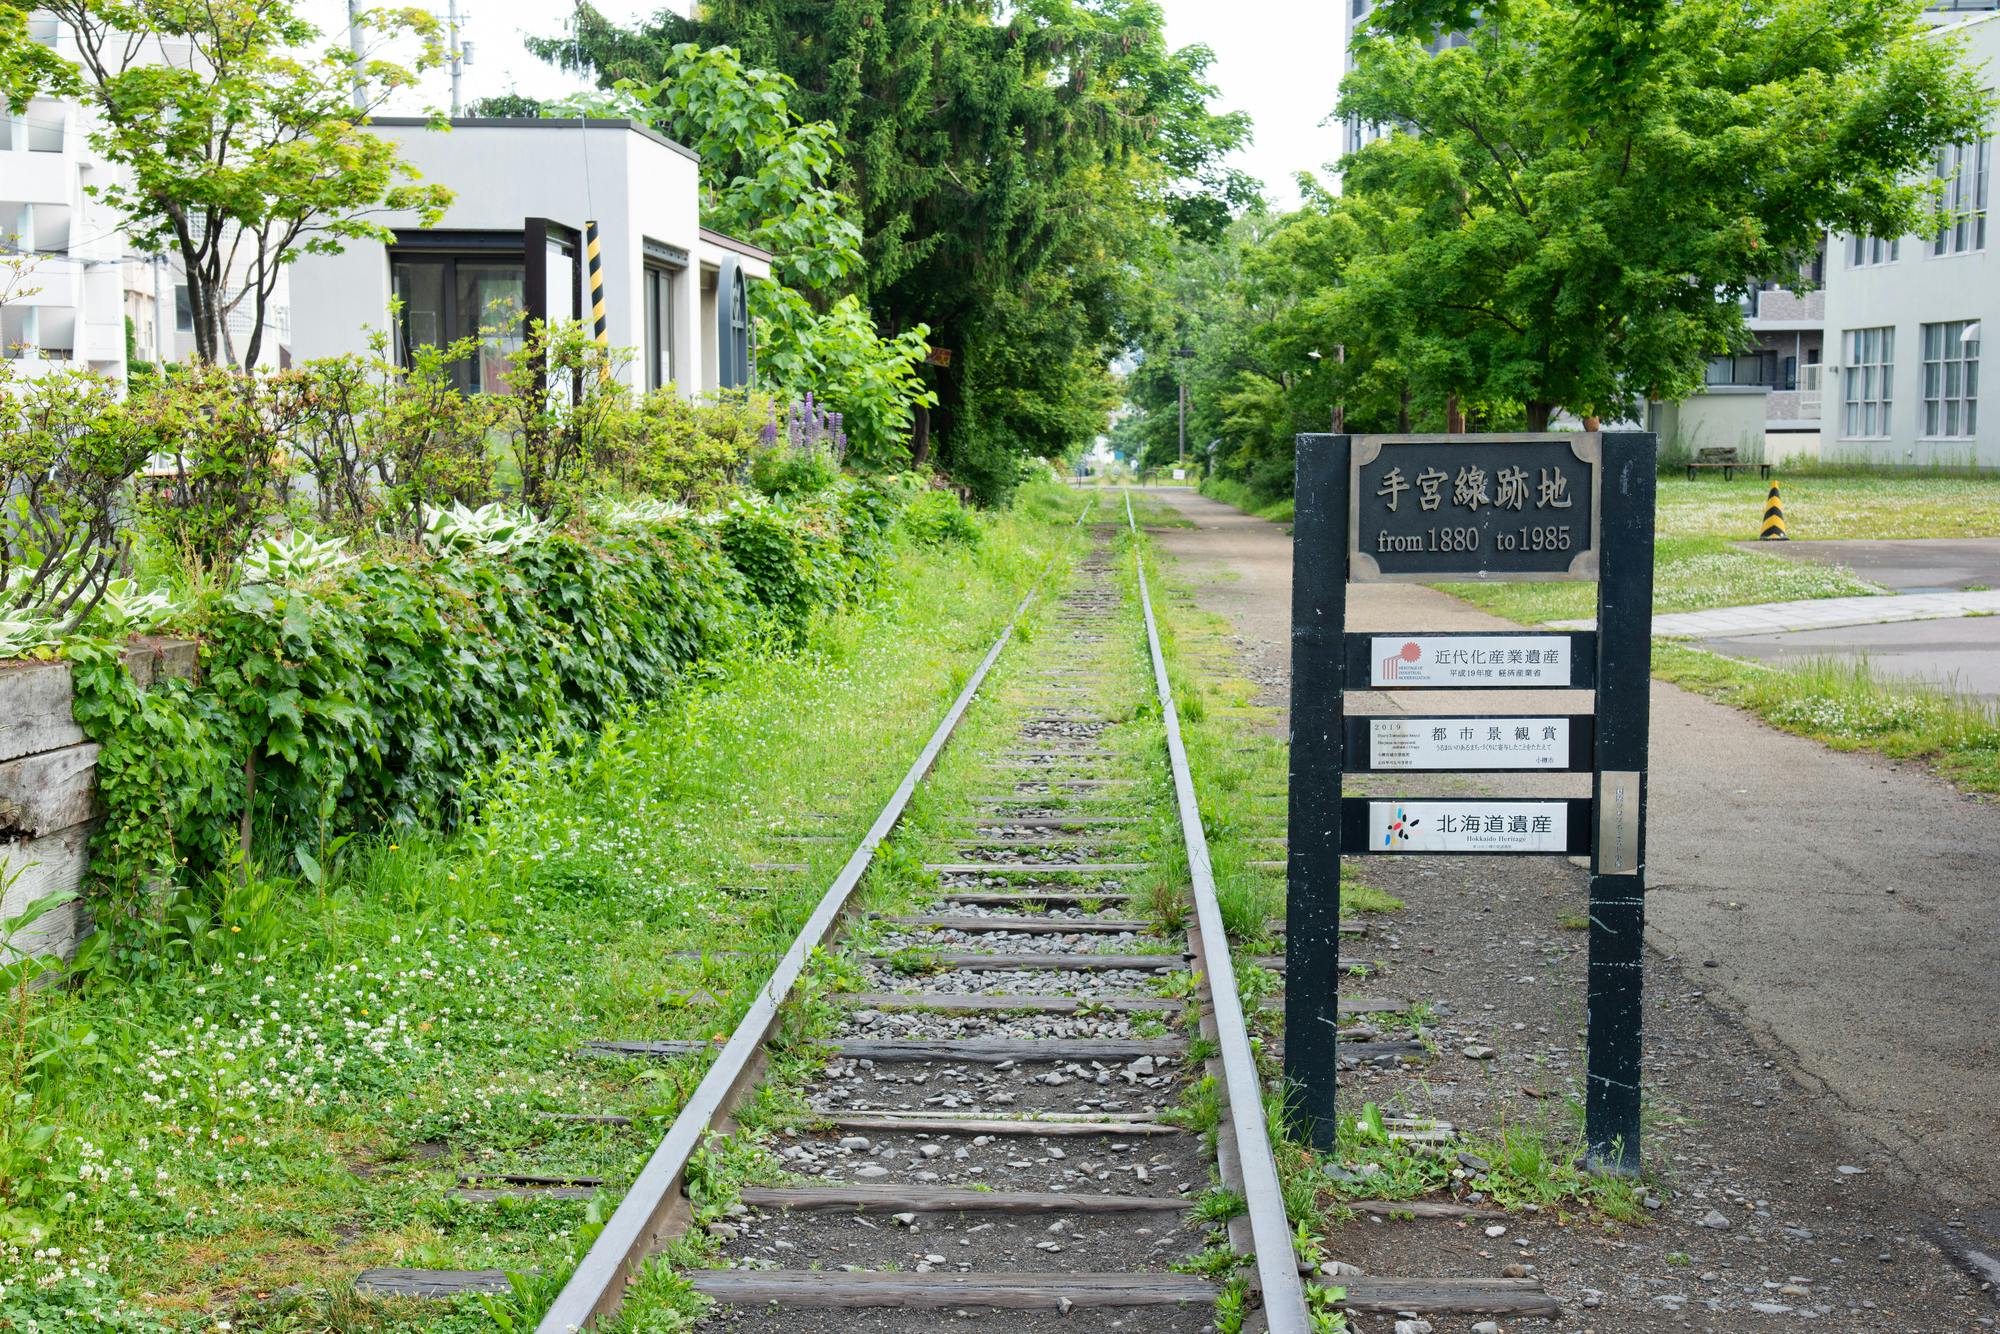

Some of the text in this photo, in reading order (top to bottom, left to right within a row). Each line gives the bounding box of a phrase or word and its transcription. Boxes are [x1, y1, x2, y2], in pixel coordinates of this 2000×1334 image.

[1376, 464, 1572, 512] 手宮線跡地
[1377, 525, 1571, 552] from 1880 to 1985
[1434, 648, 1560, 665] 近代化産業遺産
[1449, 668, 1542, 678] 平成19年度 経済産業省
[1431, 725, 1557, 741] 都市景観賞
[1436, 813, 1553, 834] 北海道遺産
[1498, 835, 1526, 843] Heritage
